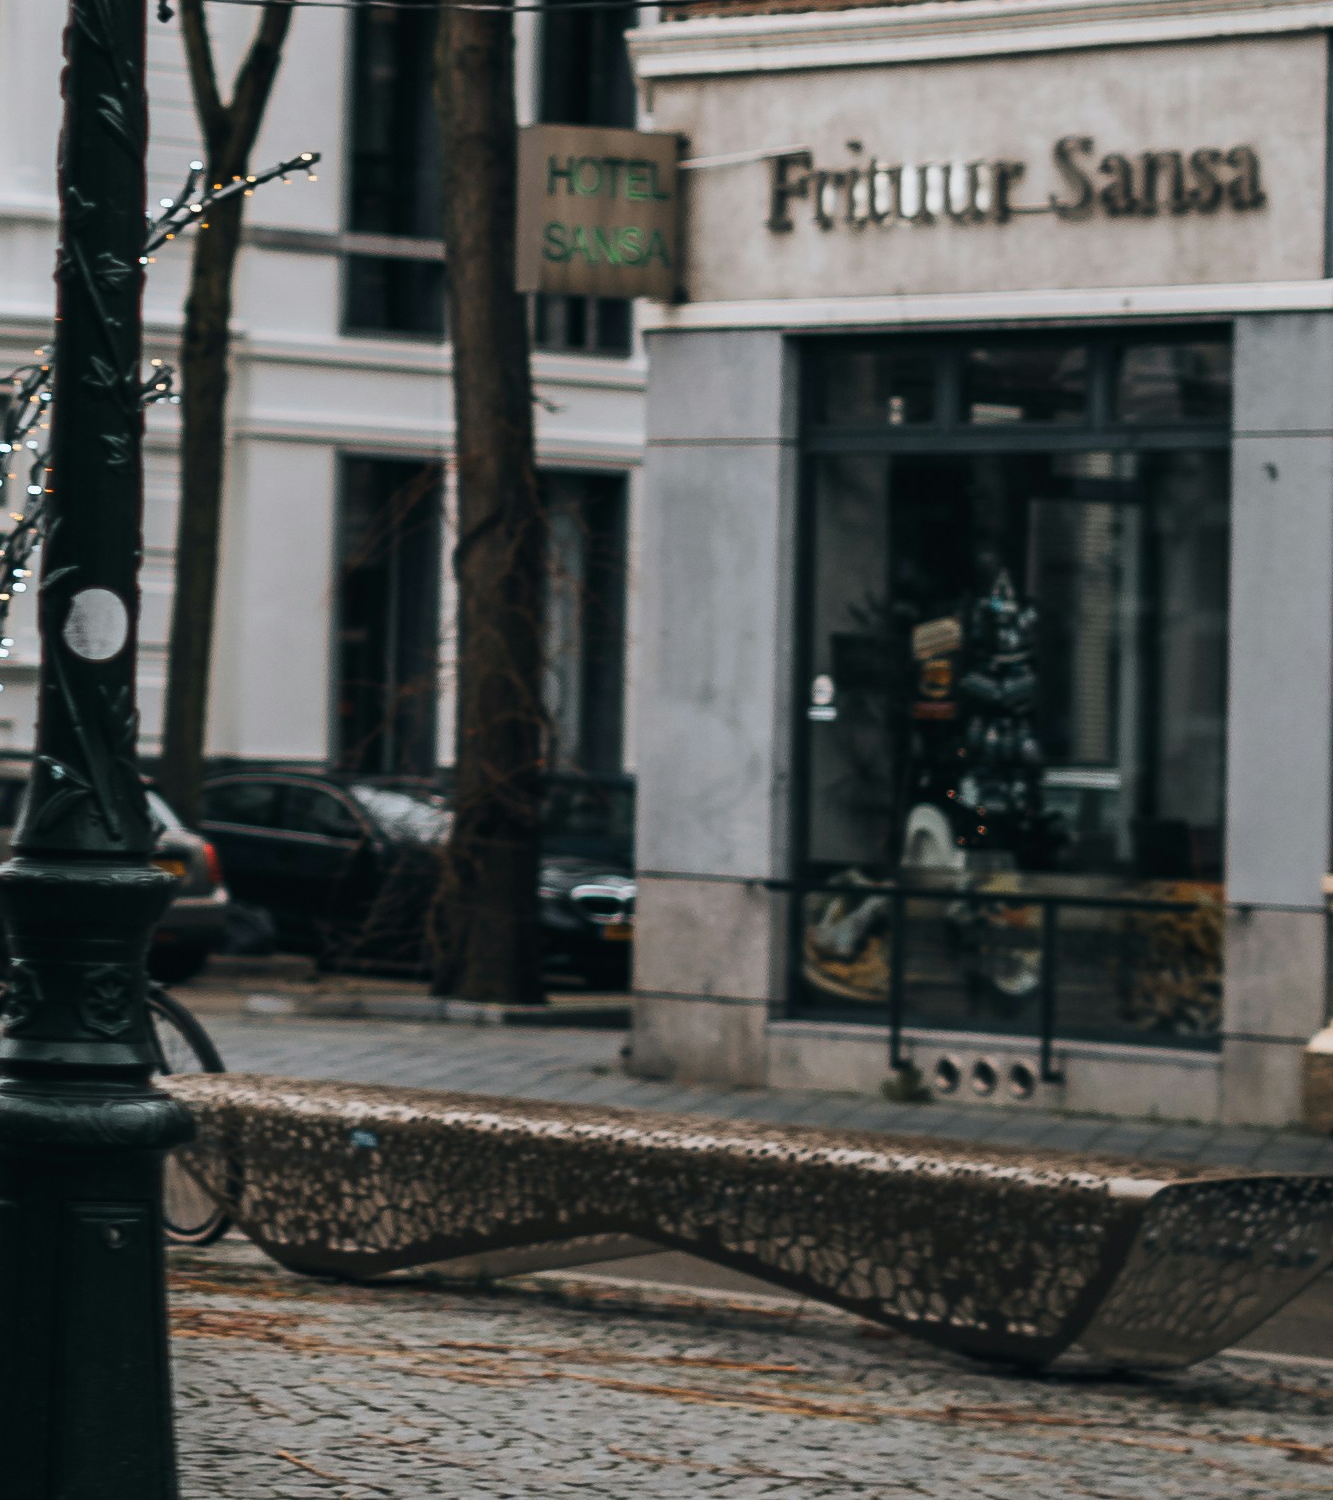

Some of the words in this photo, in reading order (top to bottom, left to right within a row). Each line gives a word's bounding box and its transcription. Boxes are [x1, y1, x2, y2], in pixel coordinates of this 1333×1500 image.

[546, 155, 670, 200] HOTEL
[766, 139, 1025, 234] Frituur
[1049, 134, 1269, 223] Sansa
[542, 220, 673, 269] SANSA
